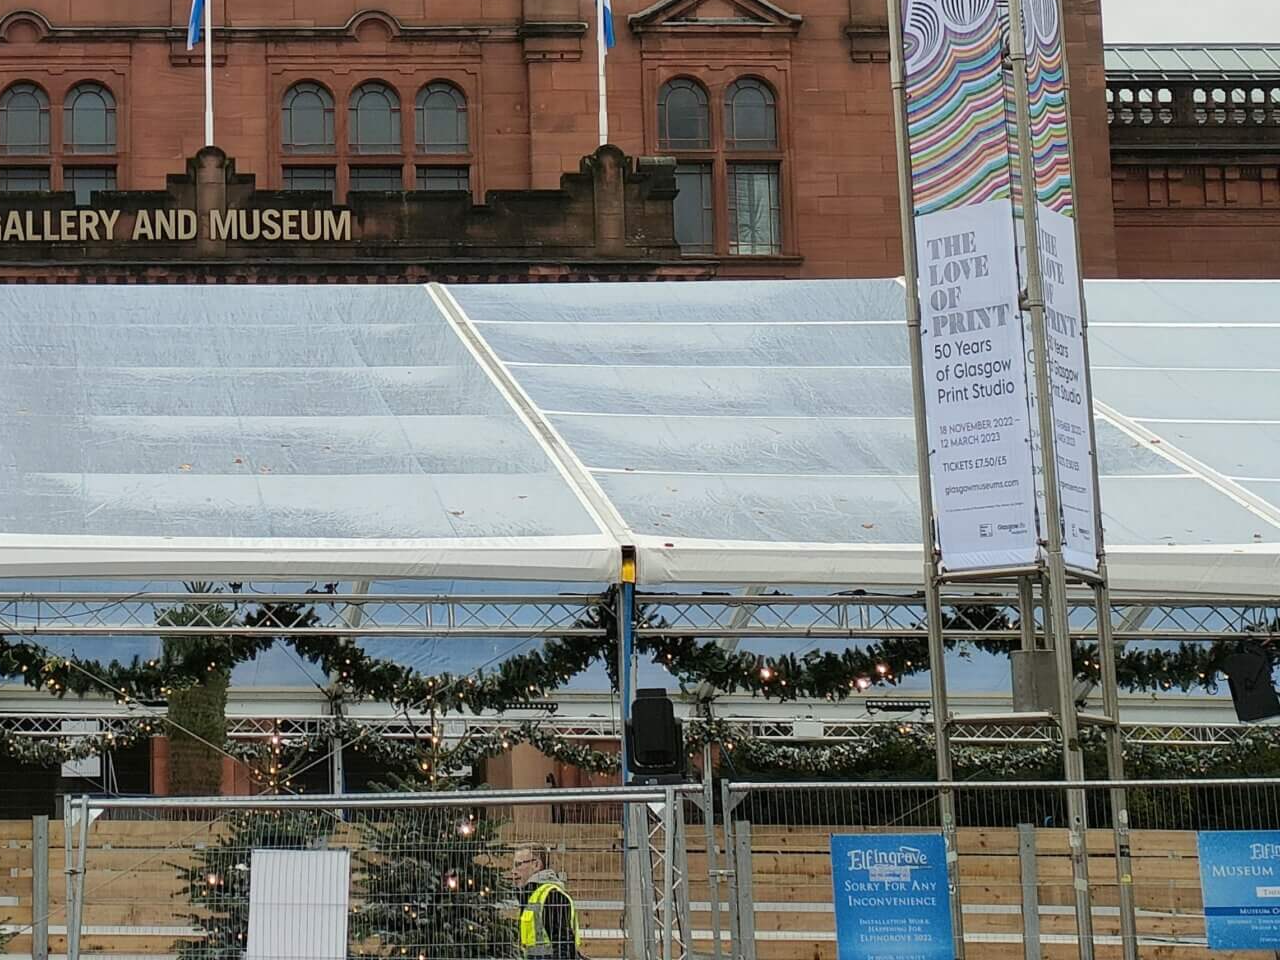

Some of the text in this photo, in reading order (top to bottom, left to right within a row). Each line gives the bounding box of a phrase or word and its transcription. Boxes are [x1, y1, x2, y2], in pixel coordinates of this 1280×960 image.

[132, 209, 197, 240] AND
[208, 209, 352, 241] MUSEUM
[926, 231, 977, 260] THE
[929, 255, 989, 287] LOVE
[930, 286, 962, 312] OF
[931, 303, 1010, 338] PRINT
[934, 339, 992, 360] 50 Years
[936, 359, 1012, 382] of Glasgow
[937, 379, 1015, 404] Print Studio
[950, 420, 992, 434] NOVEMBER
[950, 435, 980, 447] MARCH
[981, 431, 1000, 443] 2023
[943, 459, 973, 473] TICKETS
[1212, 865, 1274, 878] MUSEUM
[844, 879, 937, 892] SORRY FOR ANY
[848, 895, 937, 907] INCONVENIENCE
